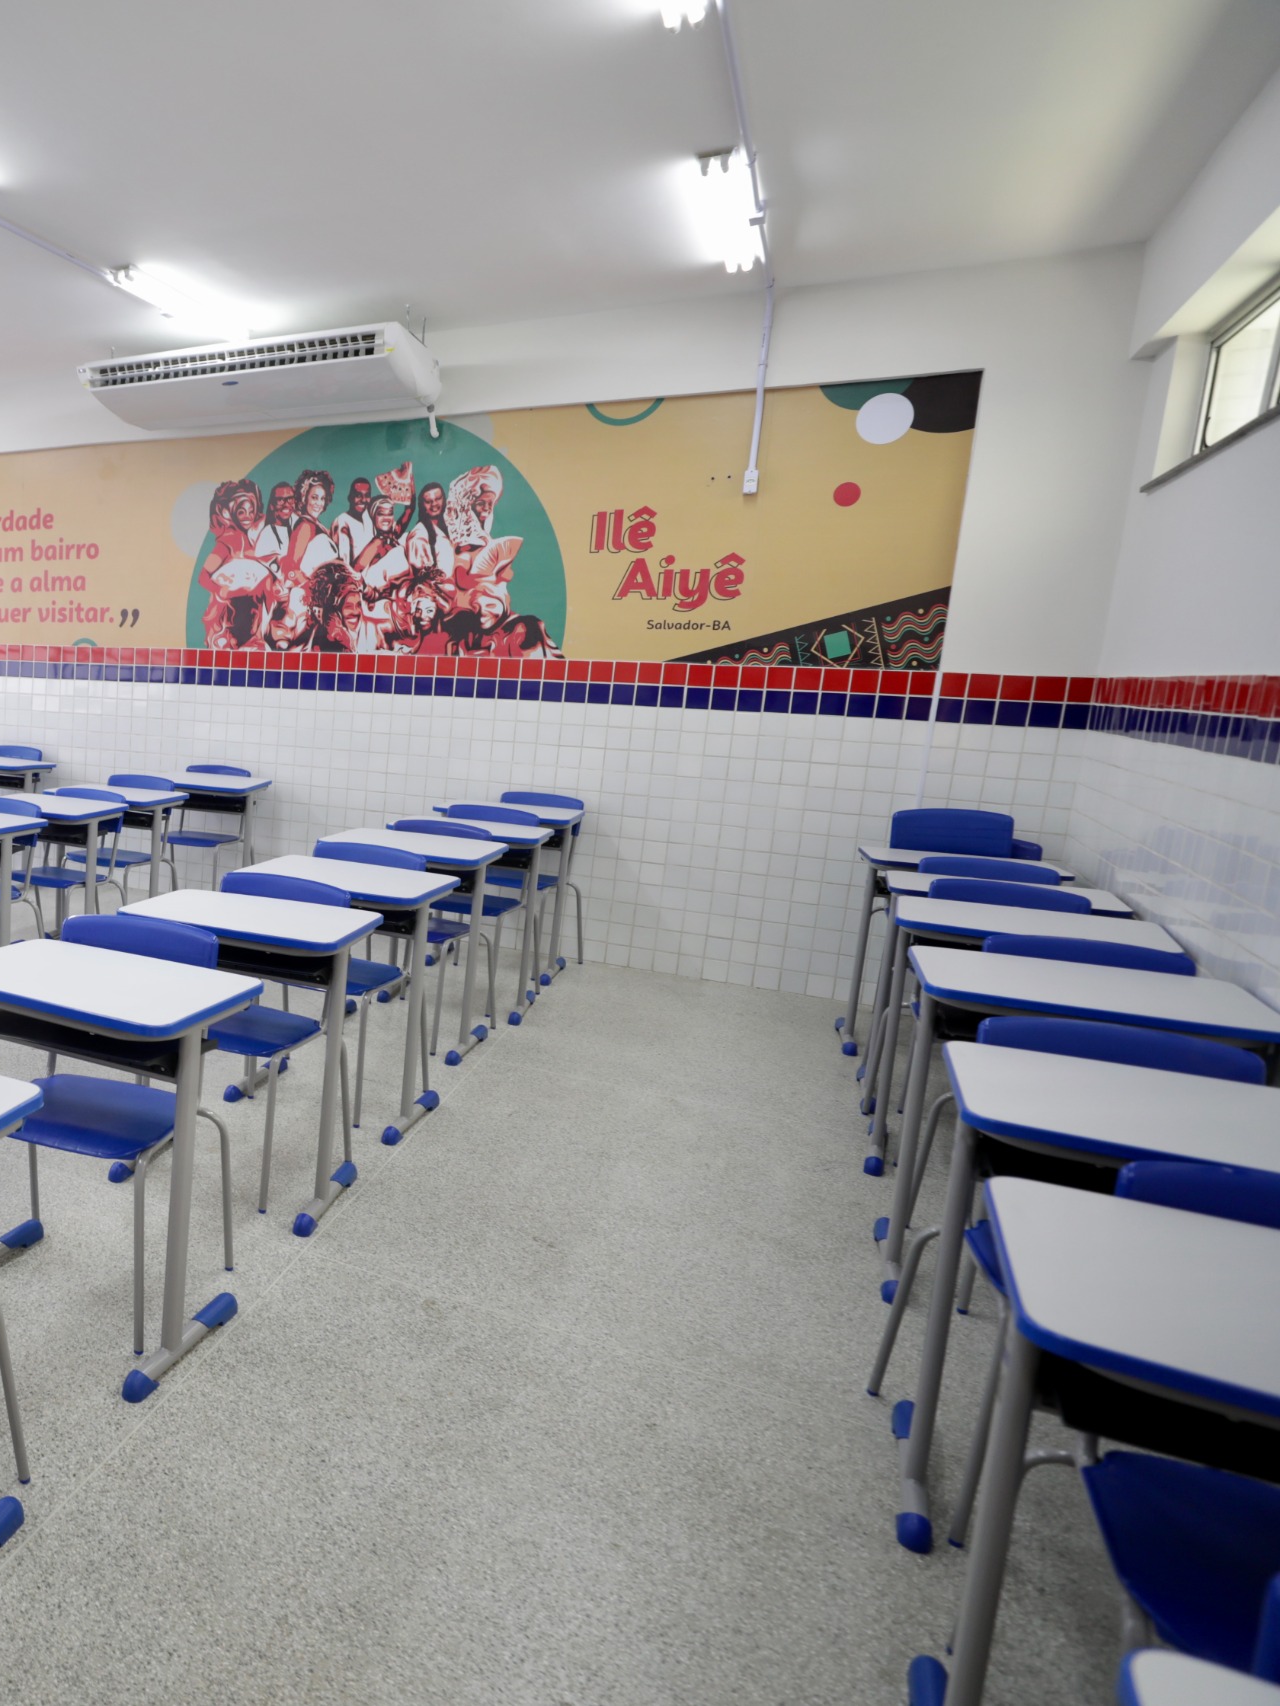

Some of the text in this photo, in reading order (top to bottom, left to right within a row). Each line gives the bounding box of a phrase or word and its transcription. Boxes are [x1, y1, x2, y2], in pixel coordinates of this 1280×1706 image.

[589, 505, 658, 554] Ilê
[30, 537, 100, 562] bairro
[10, 575, 23, 593] a
[29, 569, 87, 593] alma
[612, 552, 746, 613] Aiyê
[646, 619, 732, 632] Salvador-BA
